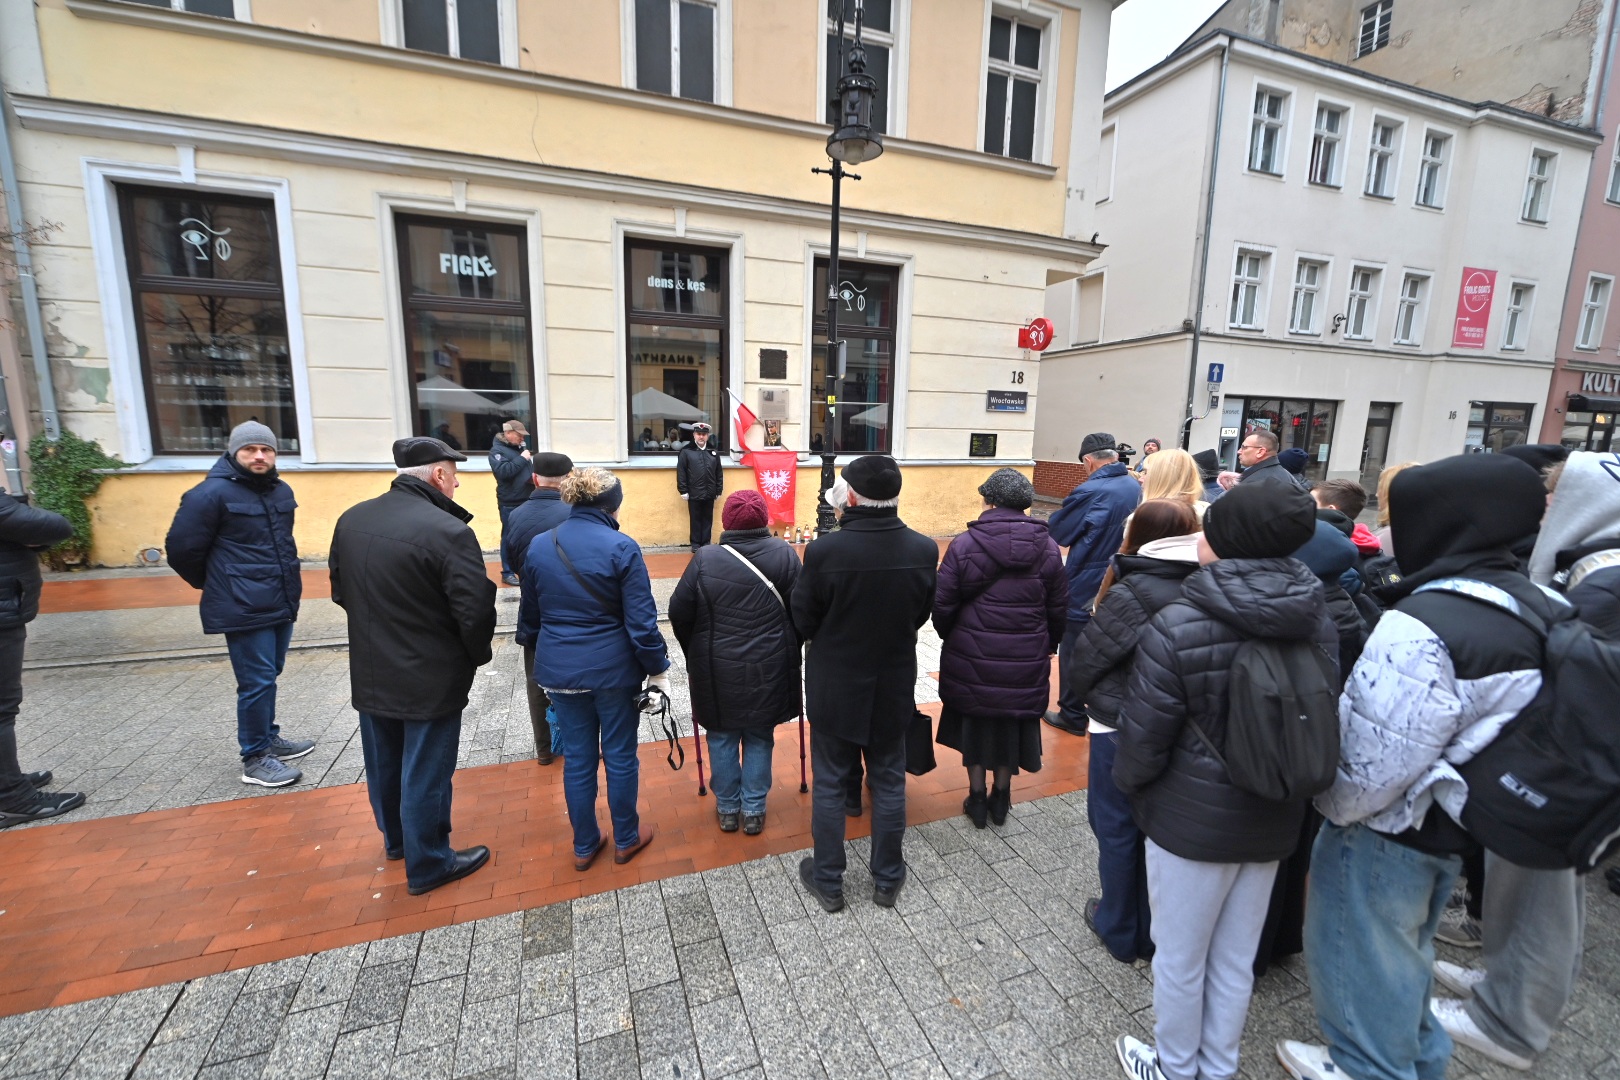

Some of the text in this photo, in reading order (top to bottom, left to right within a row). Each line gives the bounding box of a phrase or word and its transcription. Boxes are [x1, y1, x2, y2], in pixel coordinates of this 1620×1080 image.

[439, 253, 497, 277] FIGLE
[647, 275, 706, 292] dens & kęs
[1011, 371, 1024, 384] 18
[990, 396, 1025, 405] Wrocławska
[1448, 411, 1457, 420] 16
